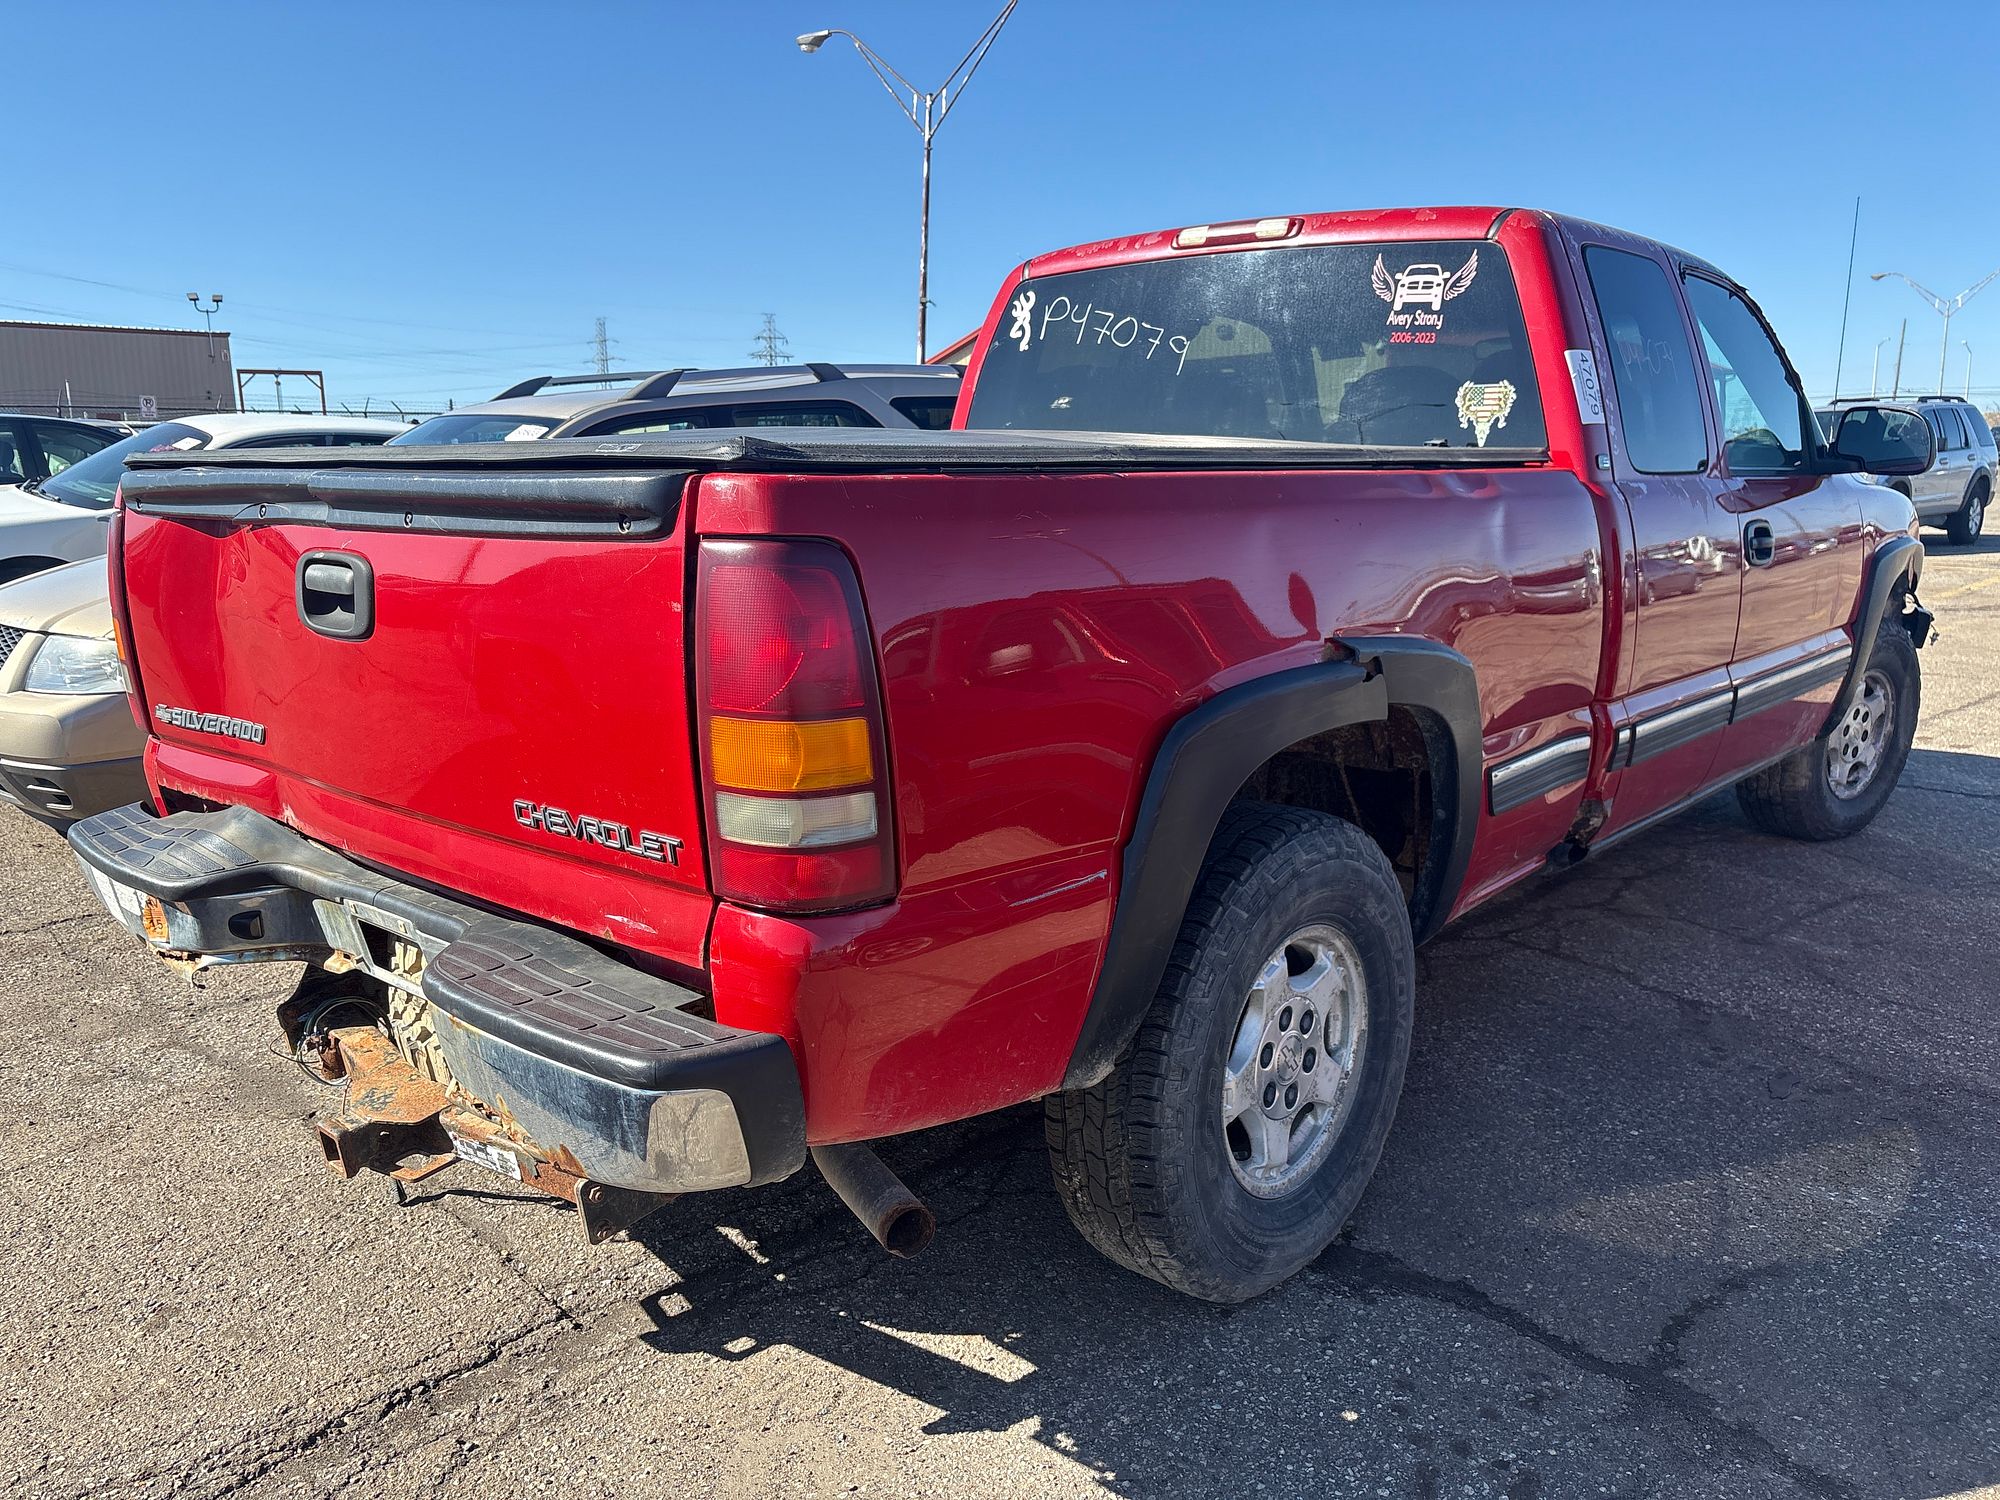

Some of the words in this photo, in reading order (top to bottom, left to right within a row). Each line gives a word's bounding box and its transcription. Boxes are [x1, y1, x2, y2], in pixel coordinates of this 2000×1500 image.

[1040, 296, 1191, 376] P47079
[1386, 311, 1414, 329] Avery
[1414, 310, 1444, 330] Strong
[1390, 332, 1437, 344] 2006-2023
[1580, 351, 1601, 416] 47079
[171, 707, 267, 746] SILVERADO
[514, 799, 685, 867] CHEVROLET
